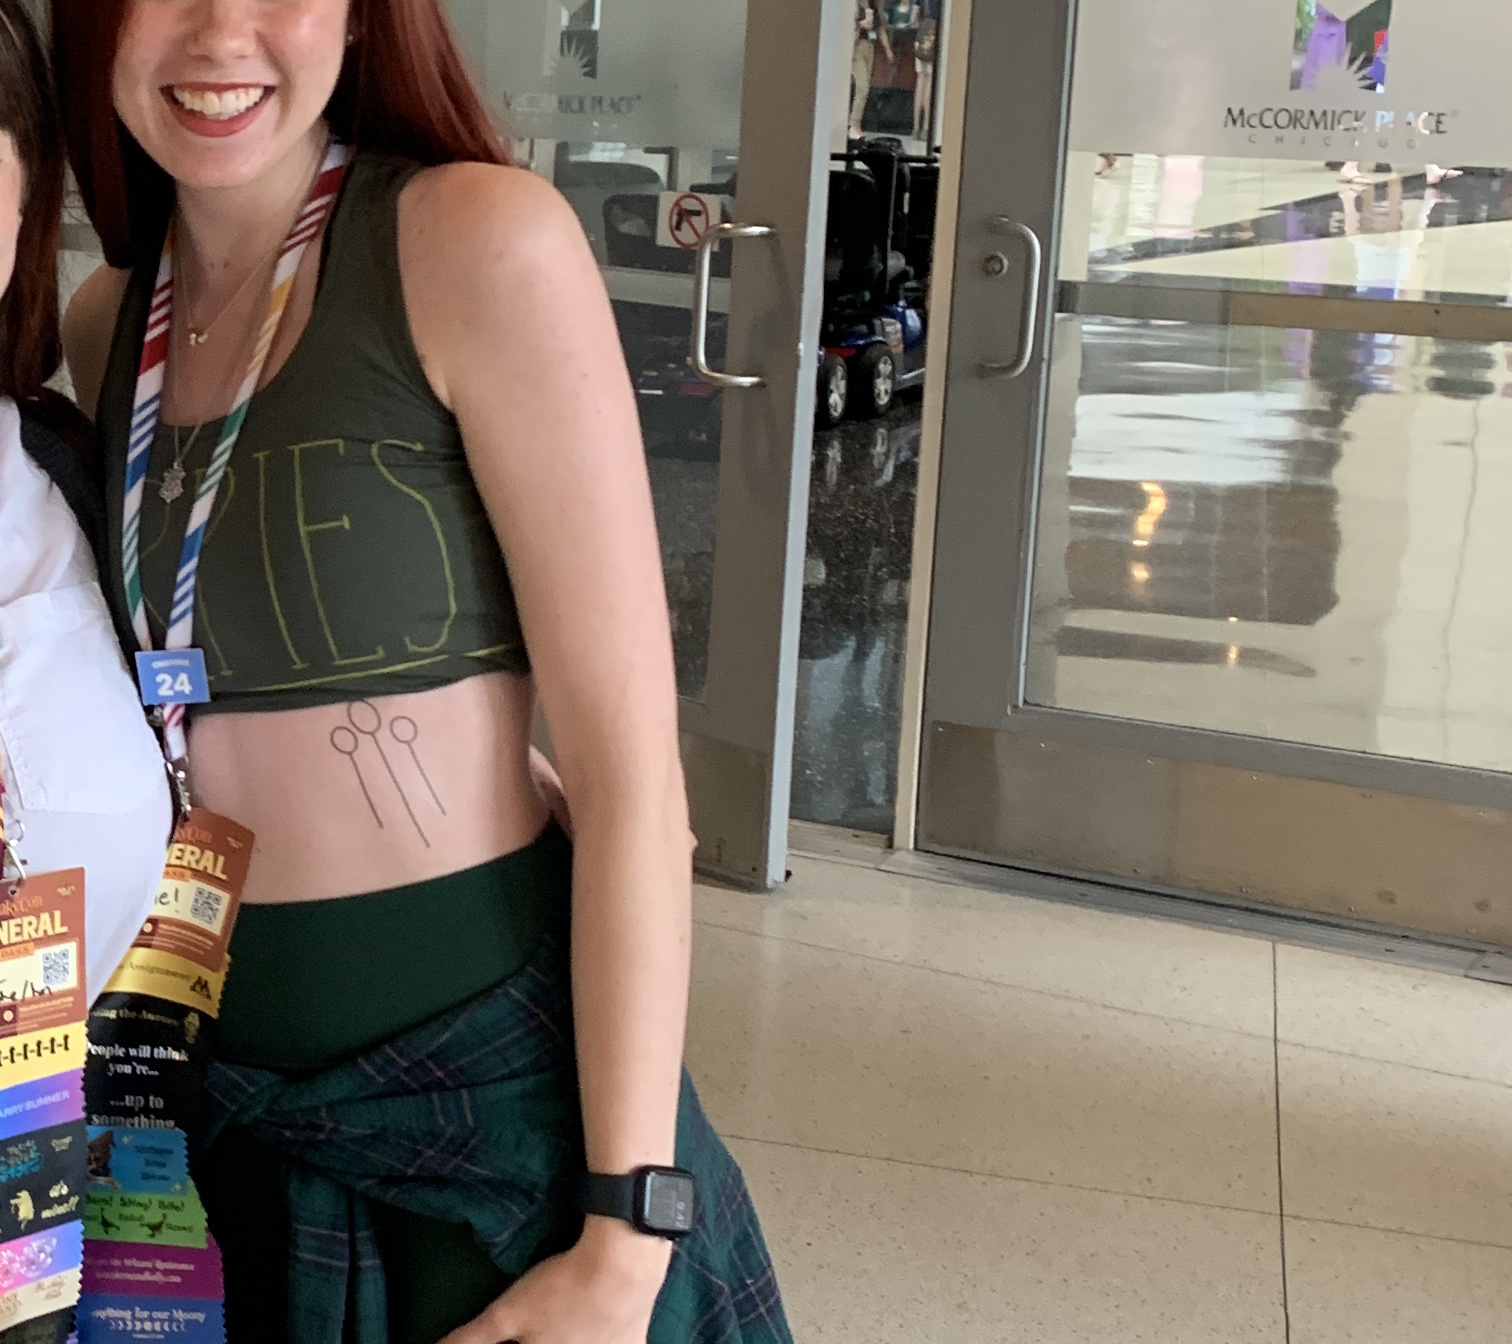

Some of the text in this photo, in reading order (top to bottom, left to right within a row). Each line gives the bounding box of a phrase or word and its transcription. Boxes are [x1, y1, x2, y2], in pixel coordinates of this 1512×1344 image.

[1223, 106, 1366, 132] McCORMICK
[155, 672, 193, 697] 24
[167, 842, 229, 881] ERAL
[128, 1044, 151, 1059] will
[153, 1045, 190, 1062] think
[149, 1094, 165, 1109] to
